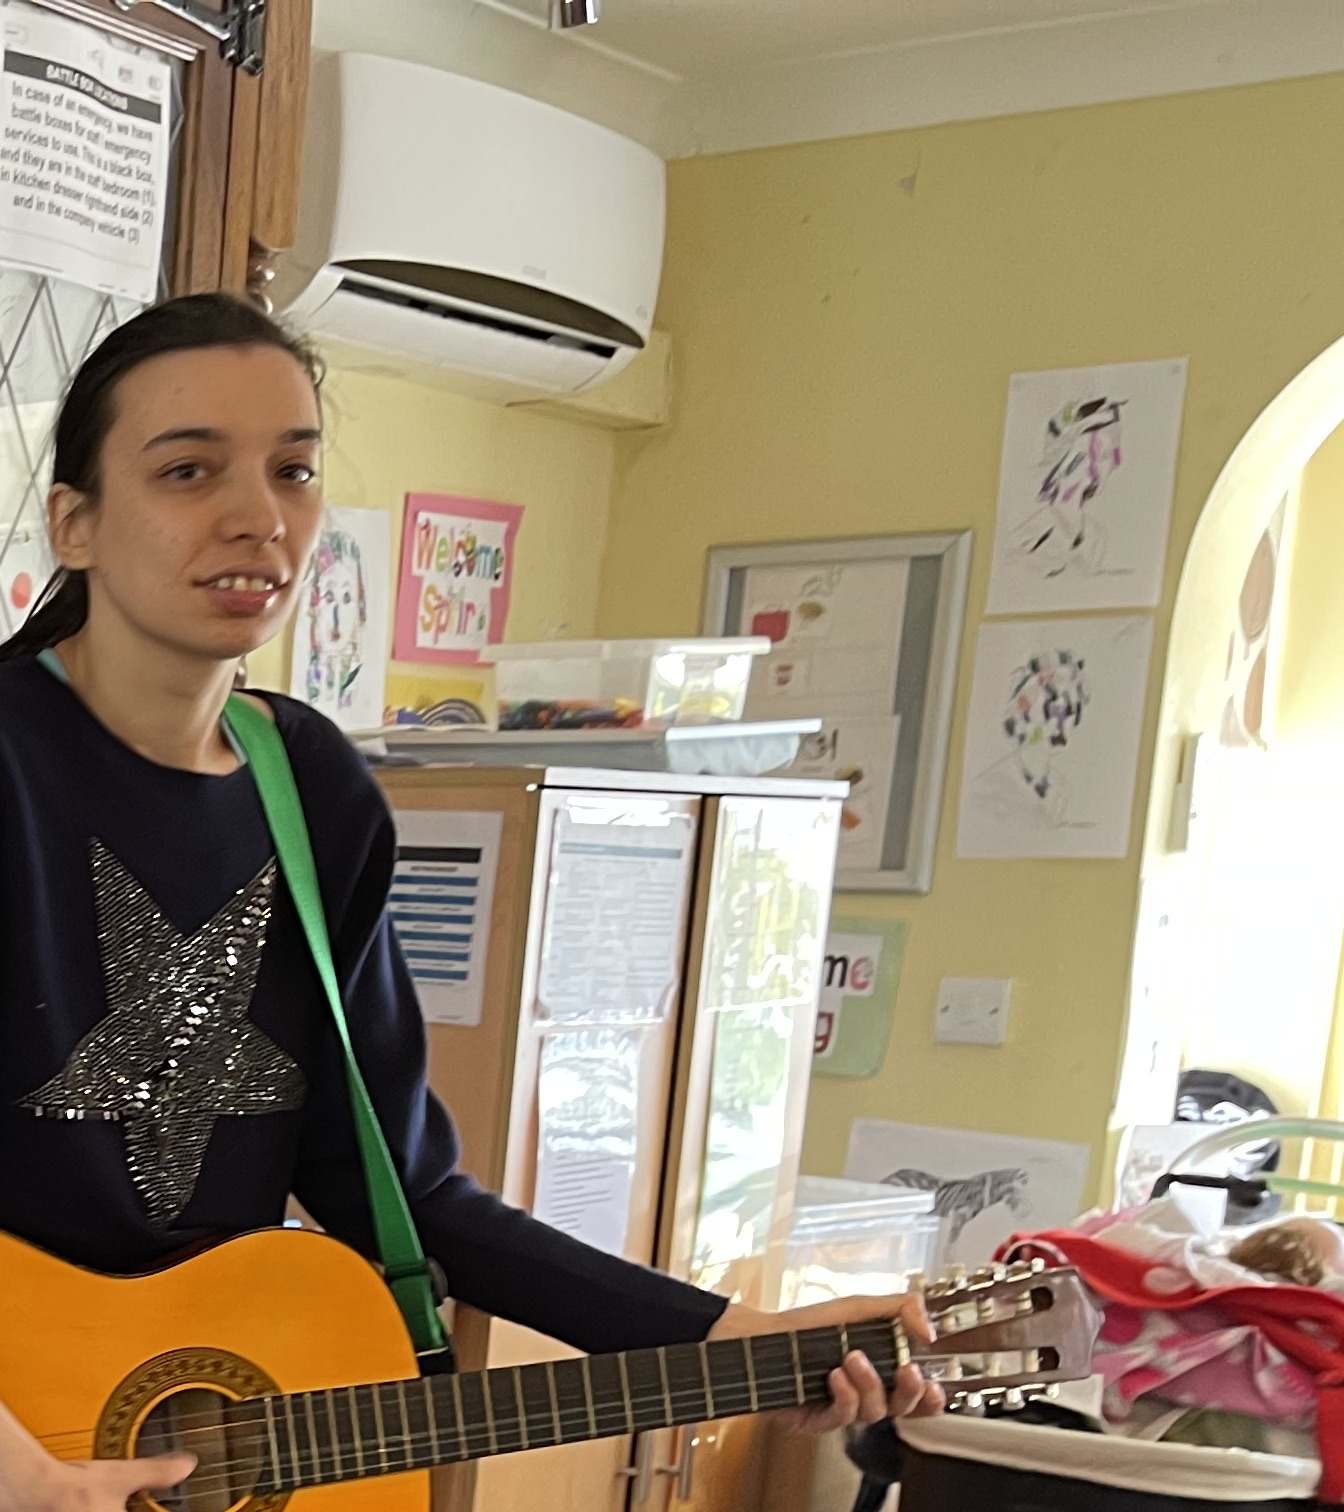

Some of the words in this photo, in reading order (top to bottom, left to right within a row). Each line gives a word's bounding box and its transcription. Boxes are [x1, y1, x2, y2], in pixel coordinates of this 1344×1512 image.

[46, 64, 80, 87] BATTLE
[13, 81, 23, 97] In
[25, 87, 51, 104] case
[53, 93, 64, 108] of
[12, 102, 42, 124] battle
[45, 111, 72, 133] boxes
[0, 148, 21, 162] and
[23, 148, 46, 172] they
[65, 162, 73, 176] in
[75, 166, 86, 181] the
[4, 127, 49, 148] services
[52, 136, 61, 151] to
[109, 159, 132, 178] black
[13, 168, 51, 192] kitchen
[13, 194, 34, 209] and
[36, 196, 46, 212] in
[48, 200, 62, 217] the
[415, 517, 505, 582] Welcome
